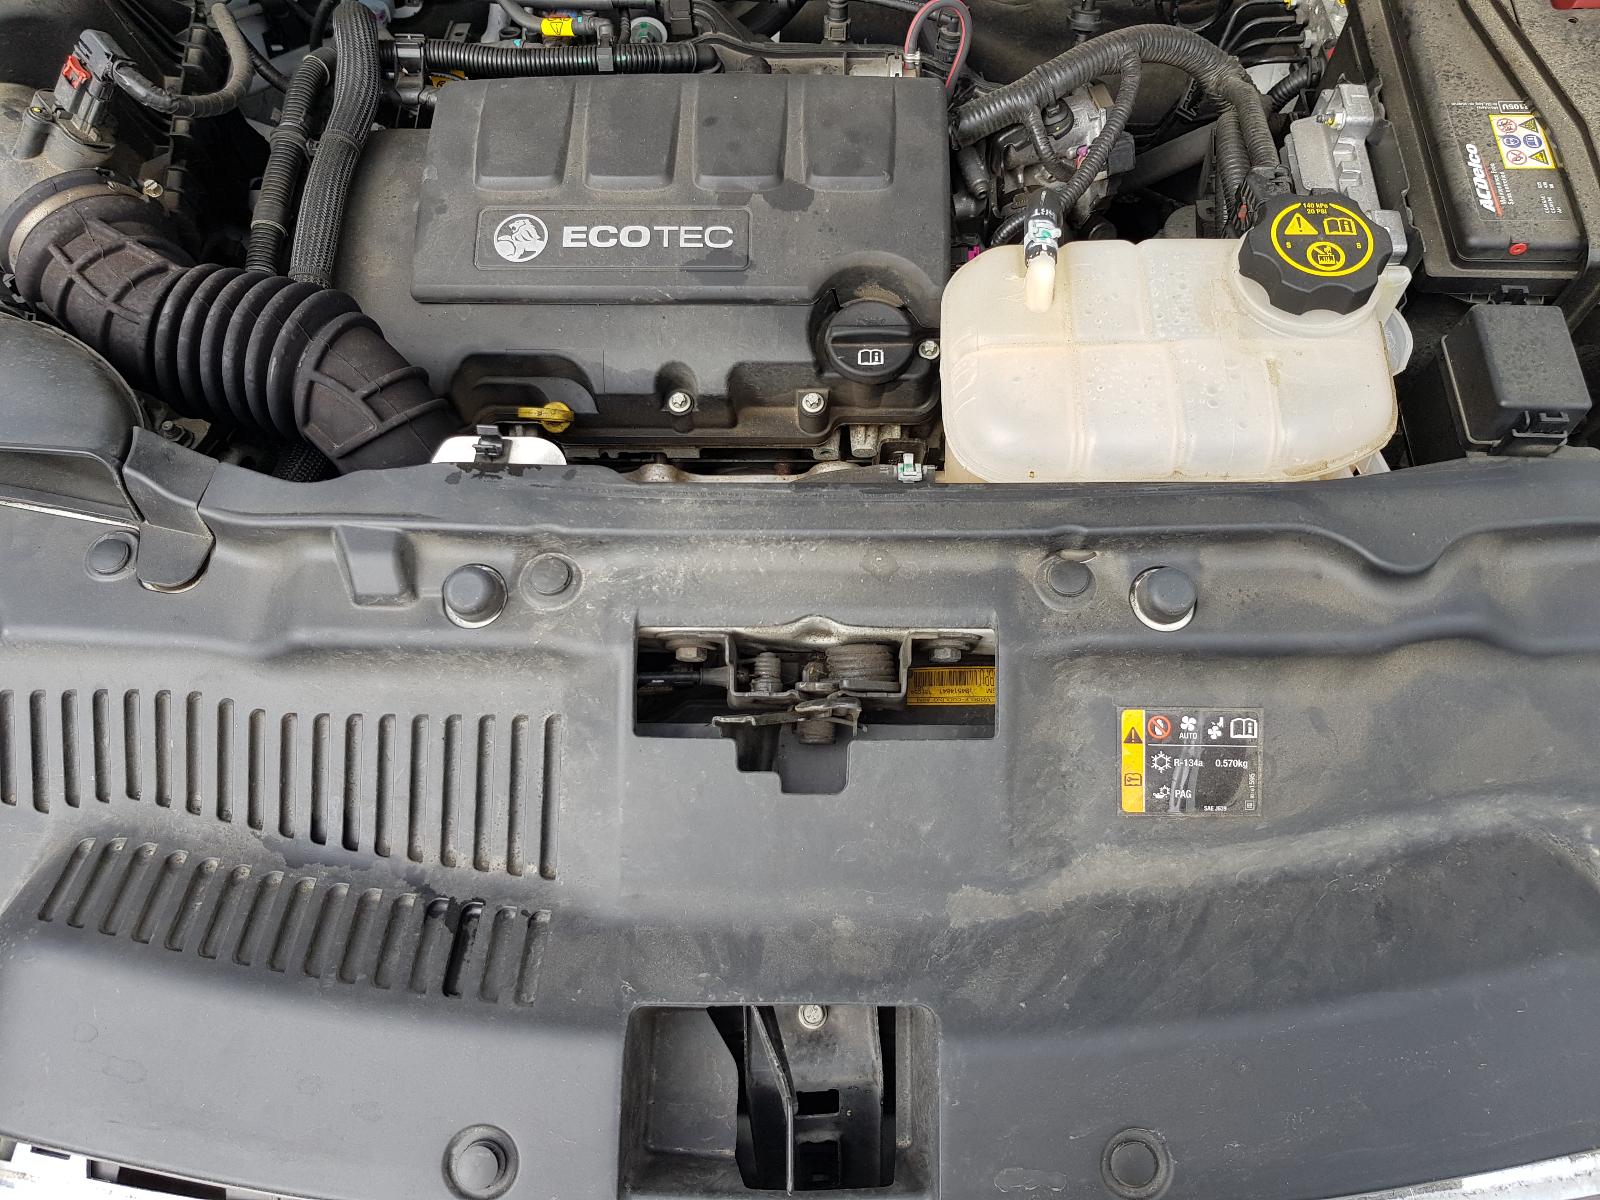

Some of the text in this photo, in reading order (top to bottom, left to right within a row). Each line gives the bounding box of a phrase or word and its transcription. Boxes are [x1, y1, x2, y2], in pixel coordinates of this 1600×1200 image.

[1465, 143, 1497, 213] ACDelco
[562, 225, 734, 249] ECOTEC
[1174, 758, 1248, 769] R-134a 0.570kg
[1175, 789, 1192, 799] PAG
